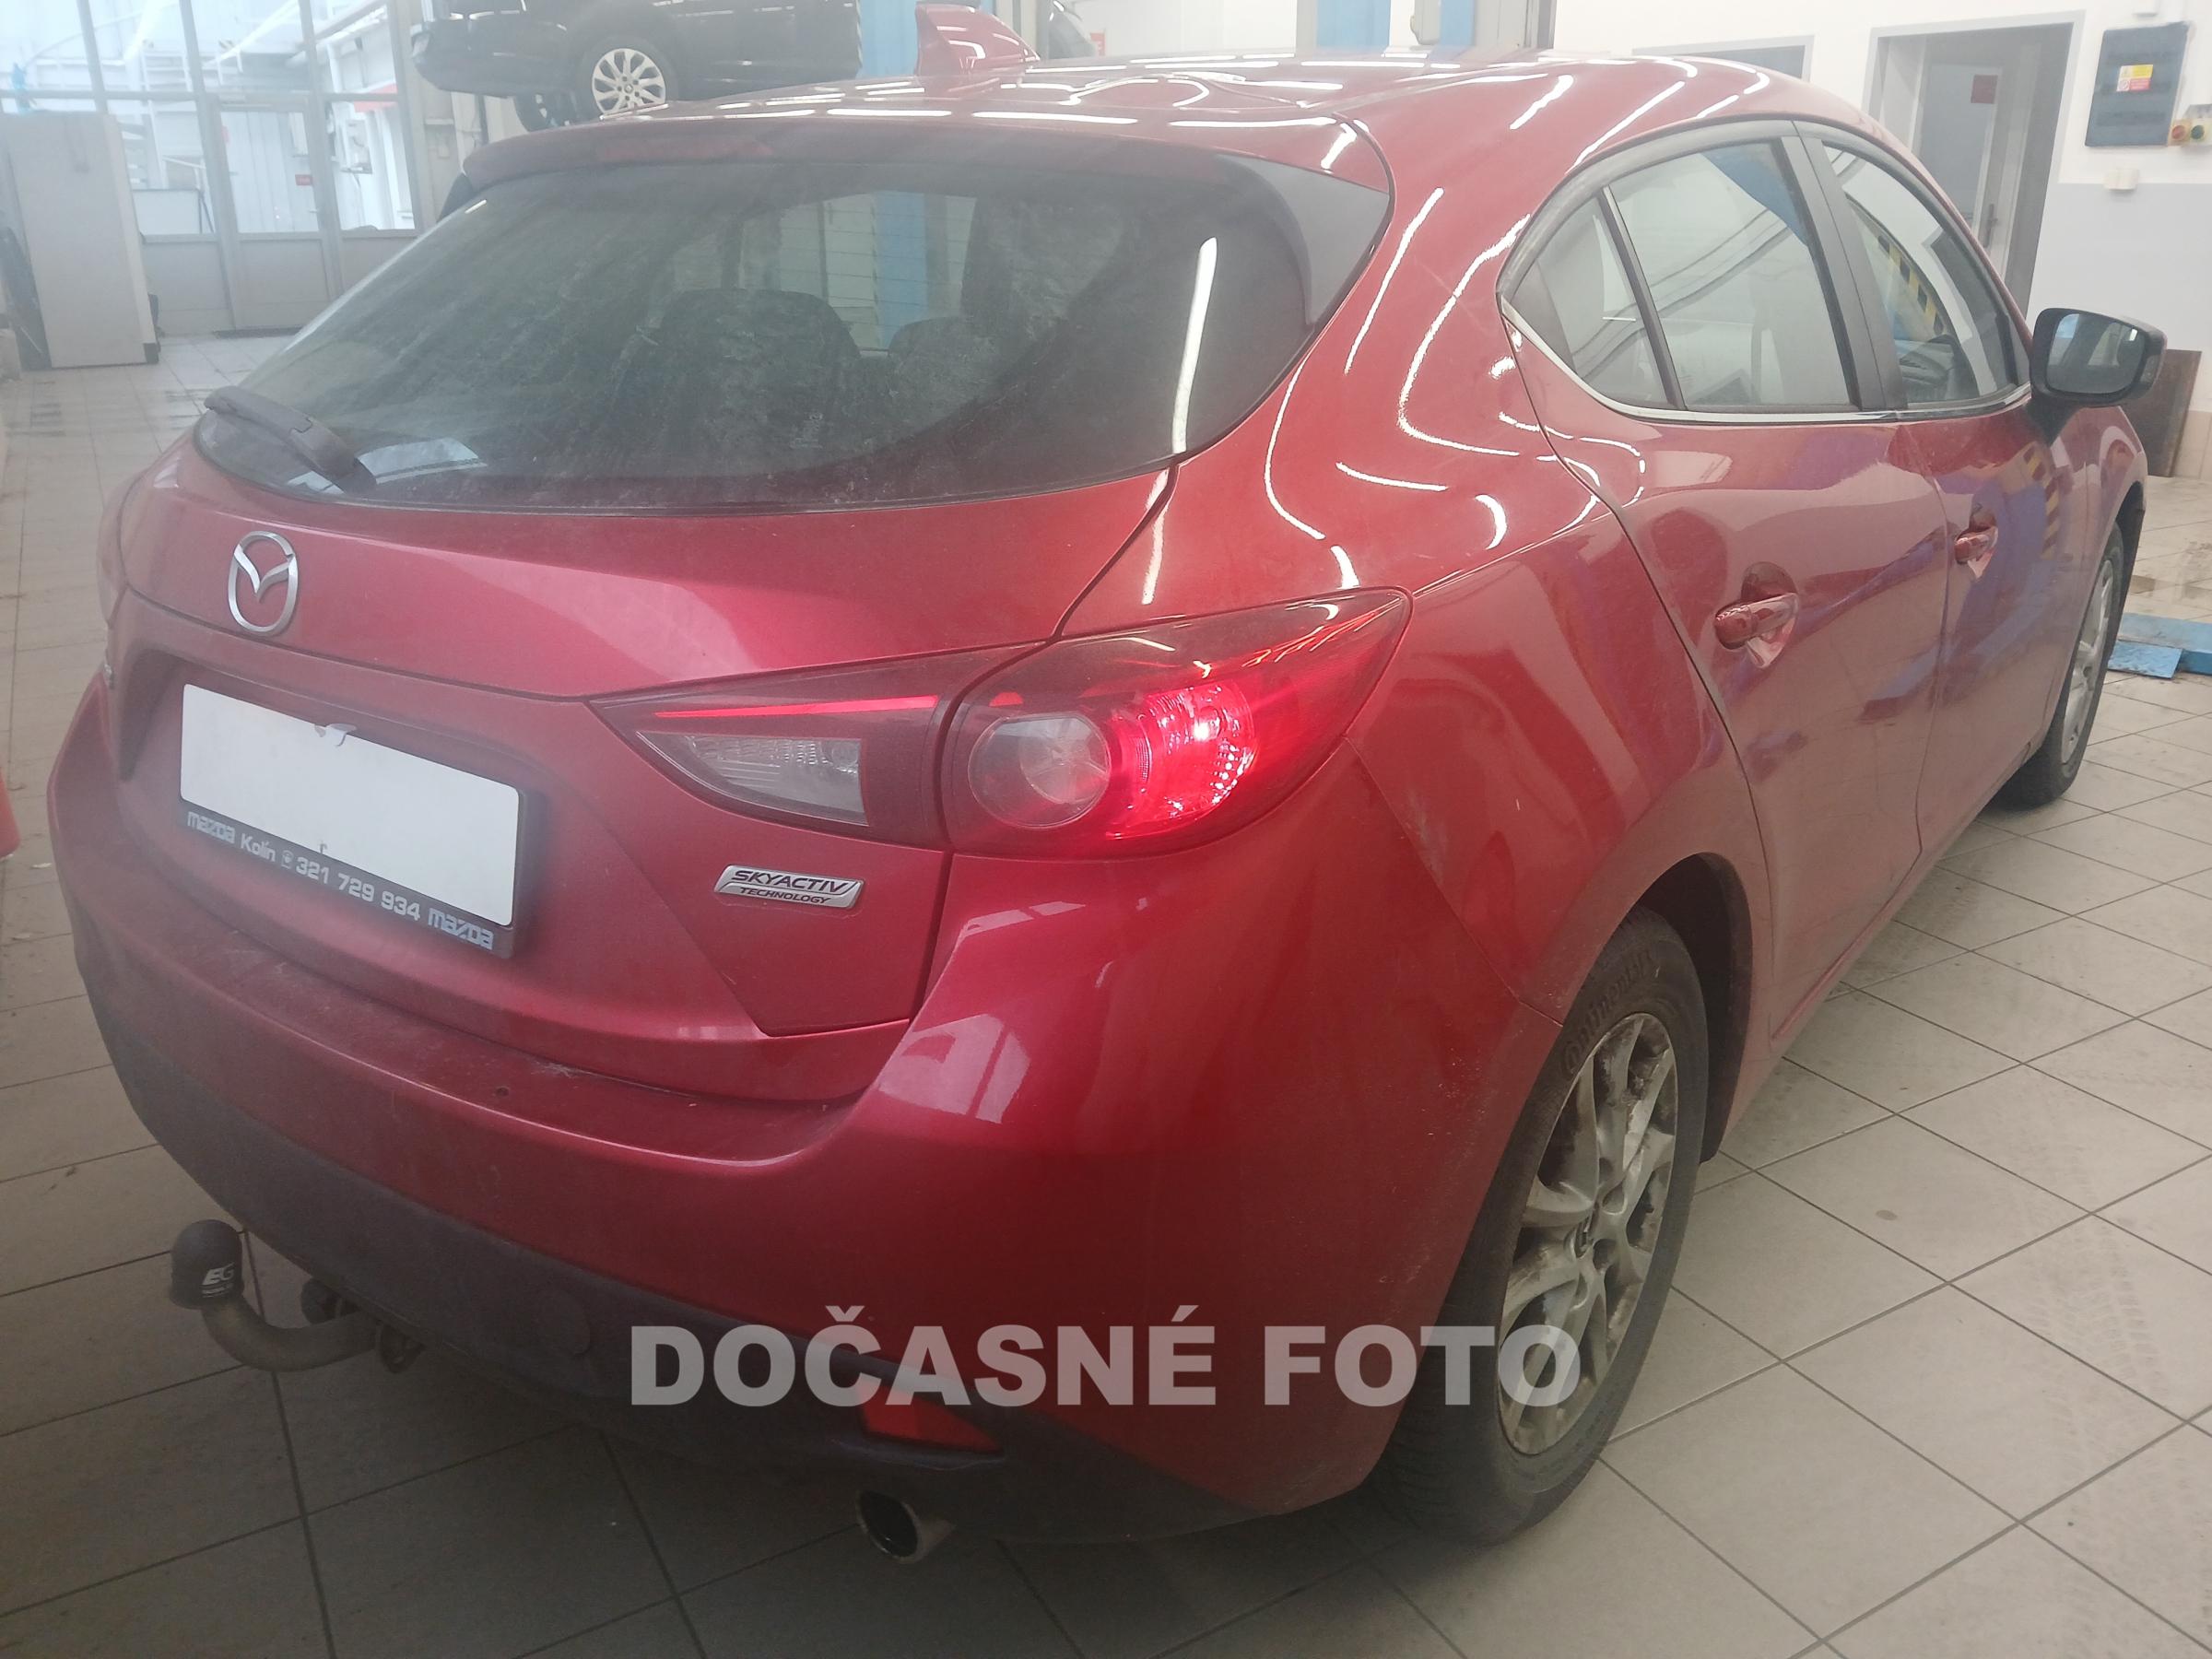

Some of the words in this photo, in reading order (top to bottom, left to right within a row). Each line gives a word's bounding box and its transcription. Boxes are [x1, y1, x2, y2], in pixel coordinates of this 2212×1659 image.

[296, 856, 329, 885] 321
[337, 873, 375, 902] 729
[381, 891, 421, 922] 934
[731, 870, 848, 893] SKYACTIV
[739, 887, 831, 904] TECHNOLOGY
